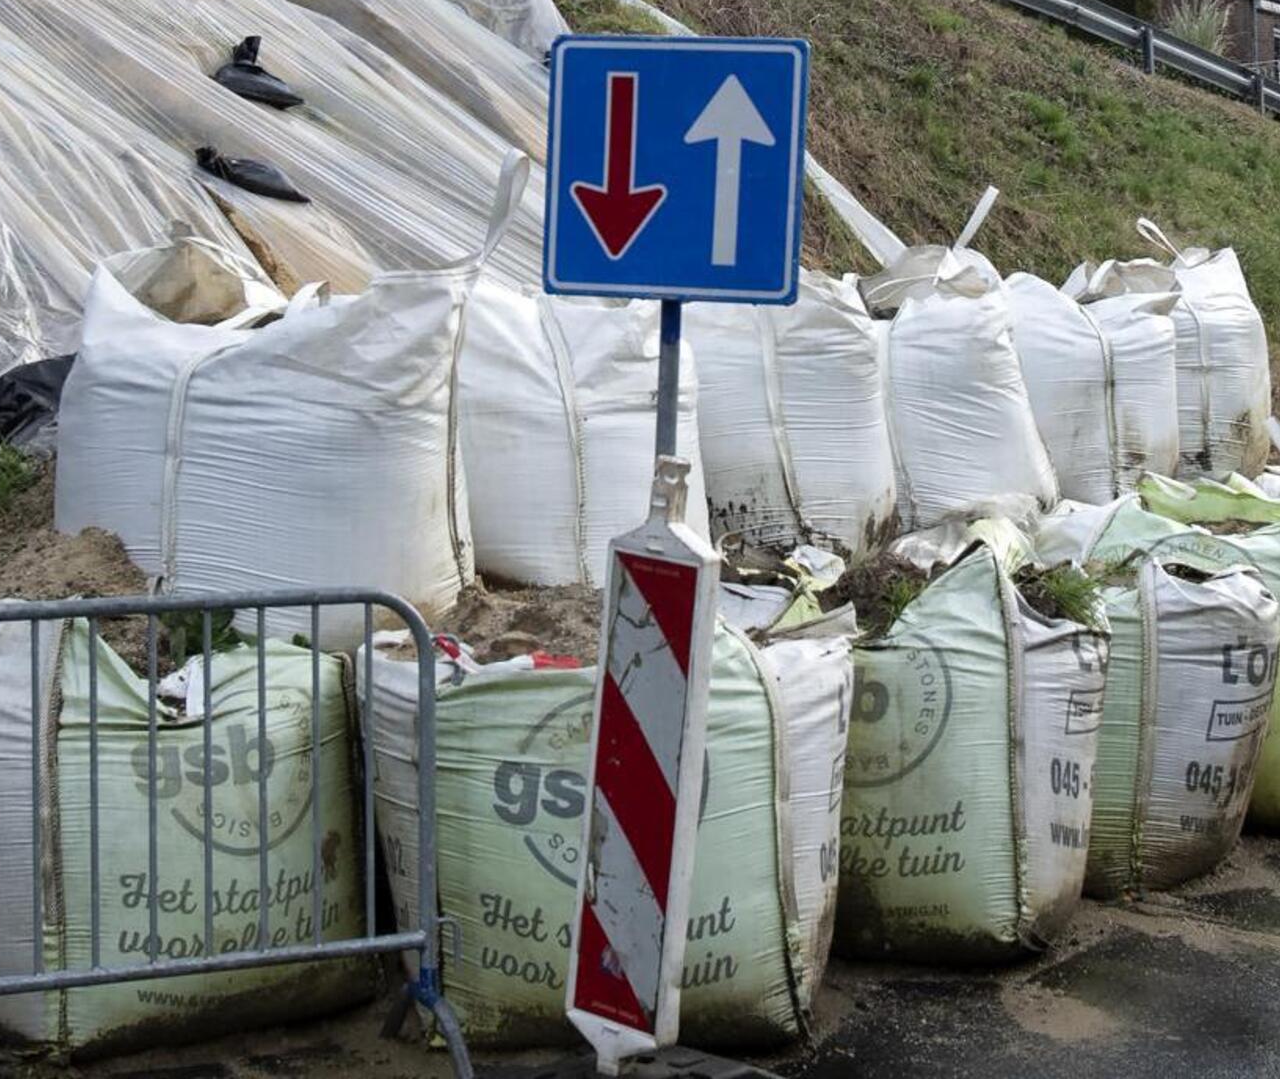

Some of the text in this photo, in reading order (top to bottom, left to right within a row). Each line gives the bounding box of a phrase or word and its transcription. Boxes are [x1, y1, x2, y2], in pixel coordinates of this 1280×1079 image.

[130, 723, 276, 800] gsb
[1050, 757, 1081, 799] 045
[492, 760, 588, 826] gs
[839, 800, 966, 851] artpunt
[898, 846, 966, 878] tuin
[120, 872, 198, 915] Het
[480, 891, 549, 942] Het
[481, 946, 564, 991] voor
